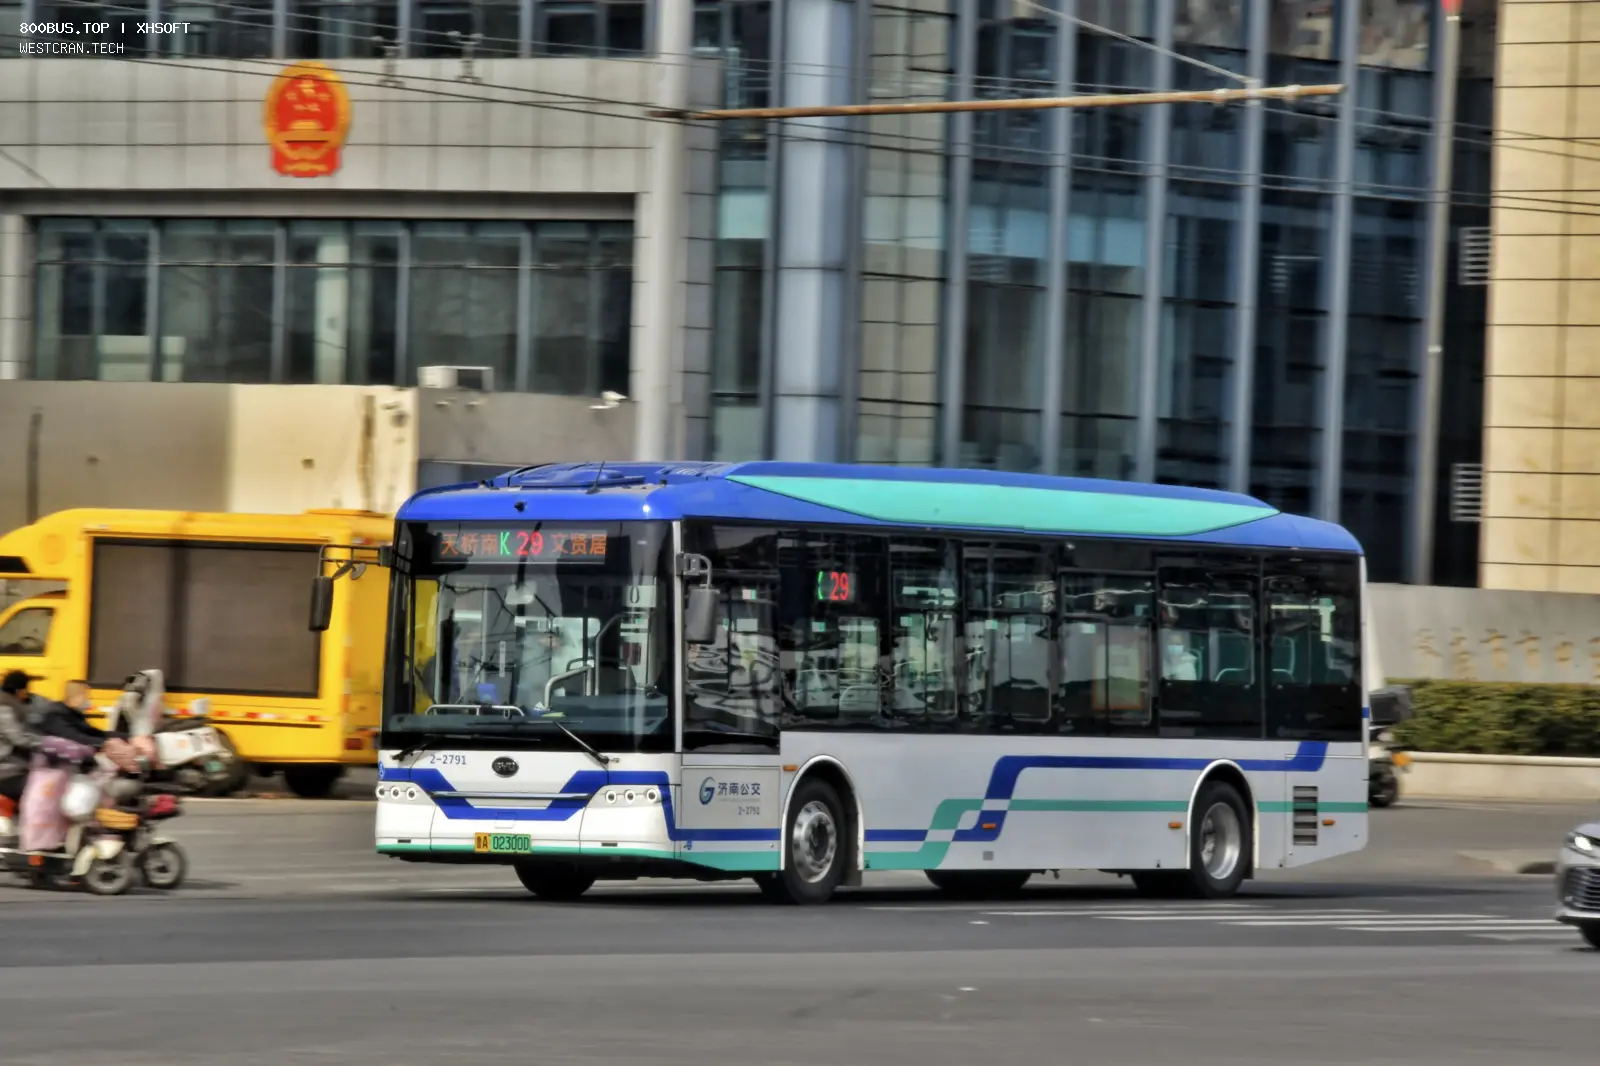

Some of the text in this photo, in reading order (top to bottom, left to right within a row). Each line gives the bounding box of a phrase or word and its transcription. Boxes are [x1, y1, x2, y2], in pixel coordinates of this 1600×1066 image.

[500, 531, 511, 556] K
[516, 531, 544, 556] 29
[829, 571, 849, 601] 29
[429, 754, 467, 766] 2-2791
[717, 782, 761, 796] 济南公交
